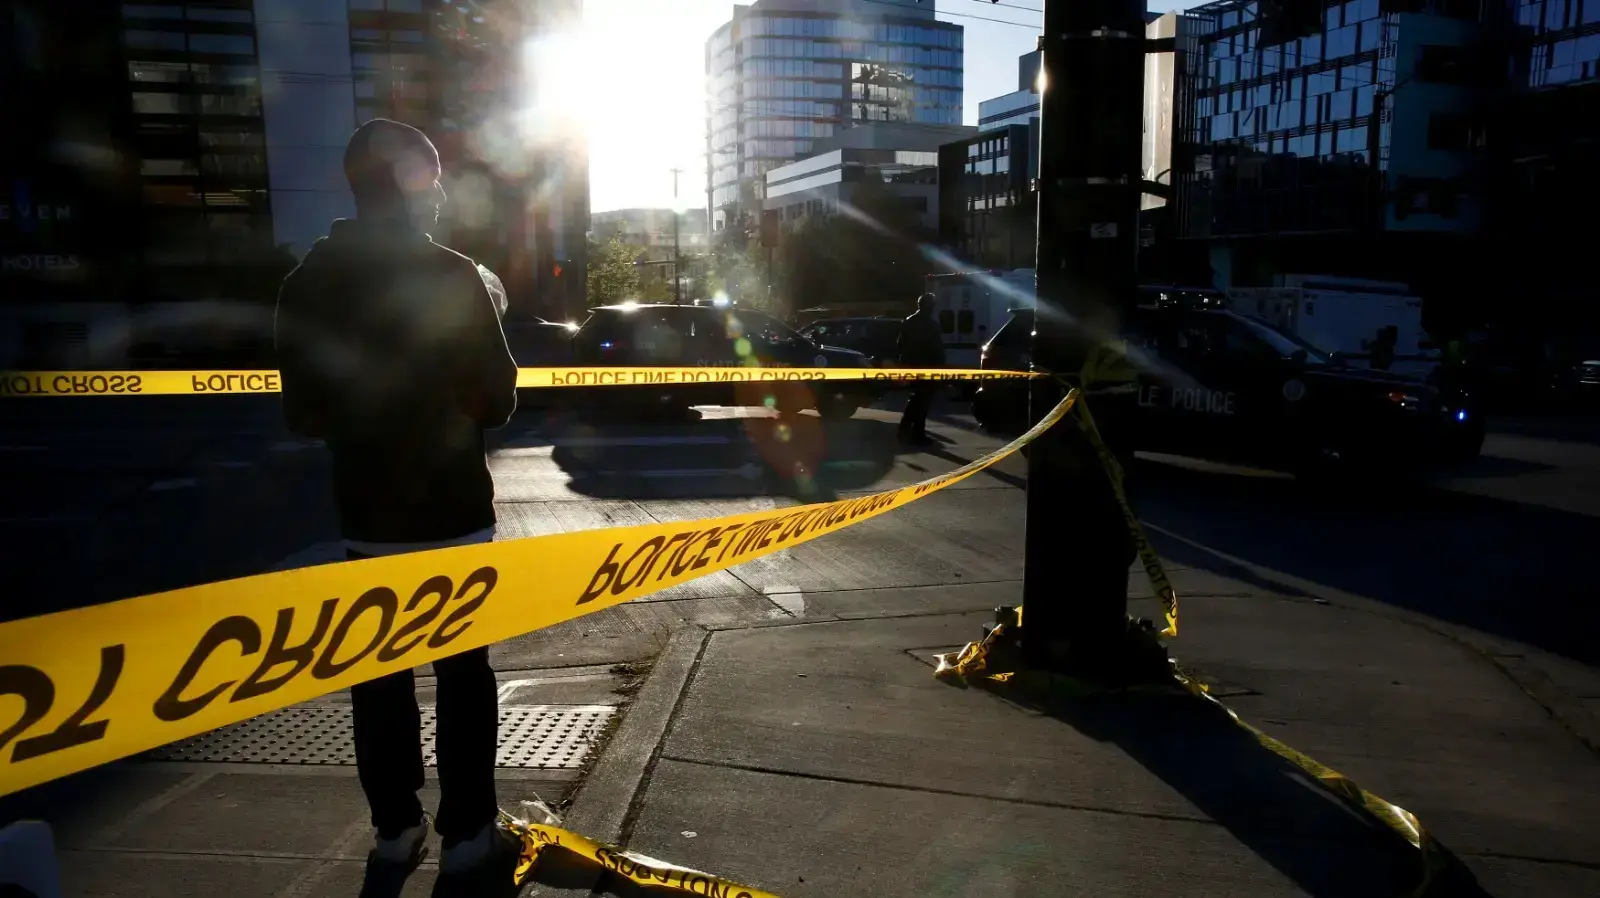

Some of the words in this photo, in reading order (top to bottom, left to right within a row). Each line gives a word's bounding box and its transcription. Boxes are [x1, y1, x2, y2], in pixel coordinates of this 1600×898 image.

[0, 202, 71, 220] EVEN
[1, 254, 80, 270] HOTELS
[1172, 387, 1237, 415] POLICE
